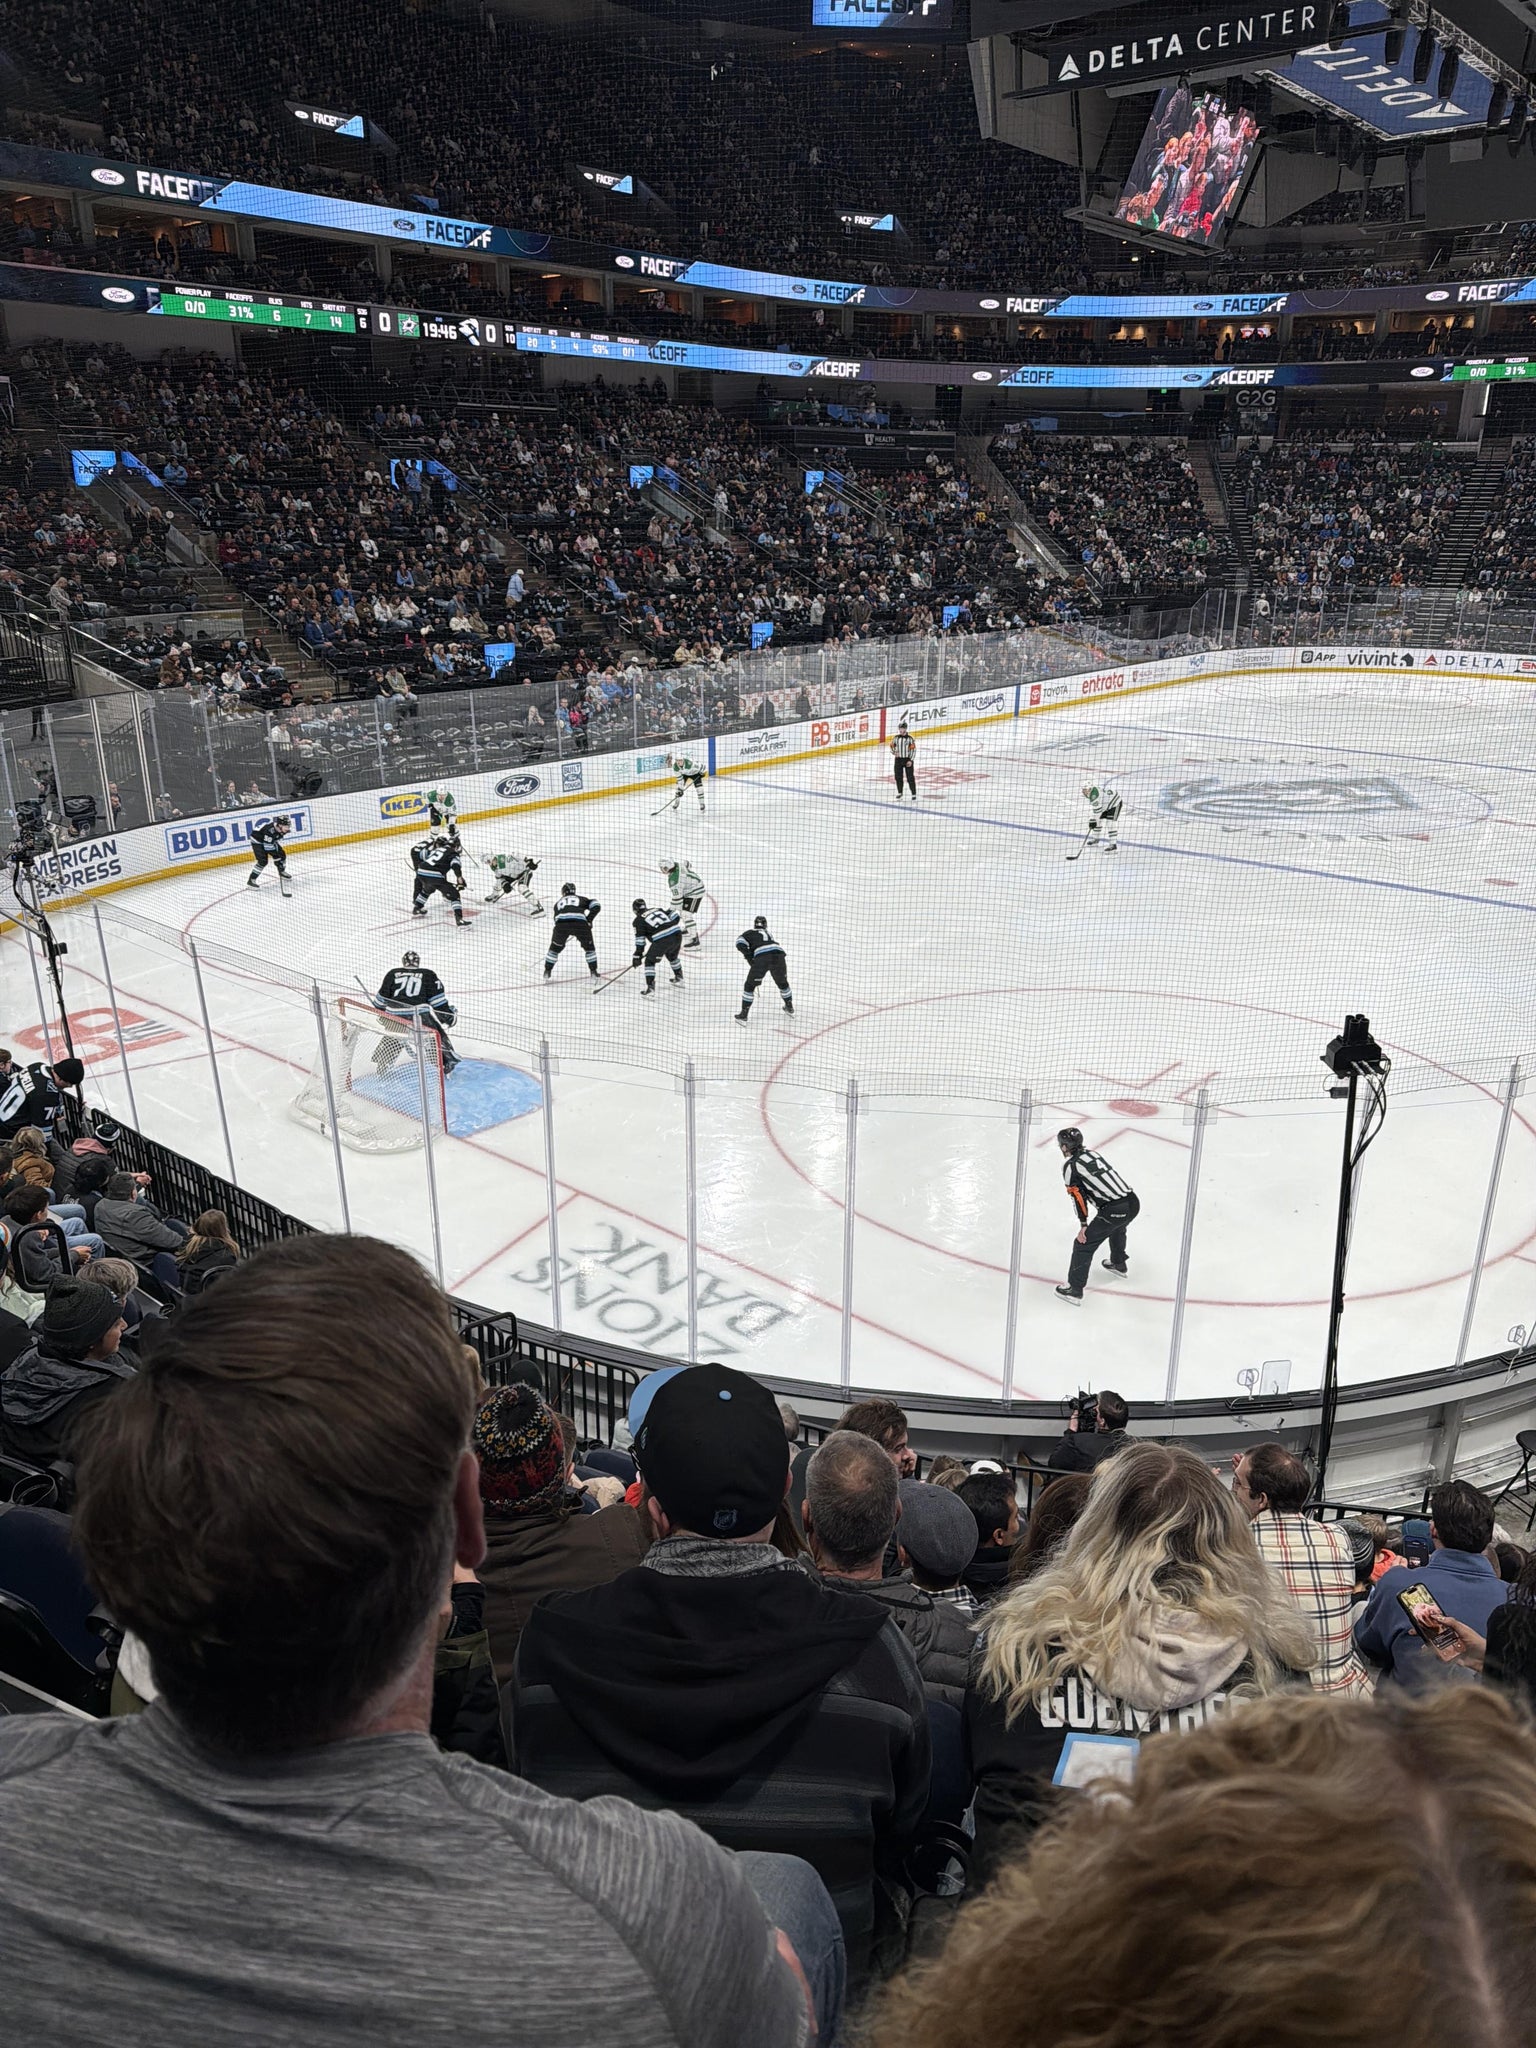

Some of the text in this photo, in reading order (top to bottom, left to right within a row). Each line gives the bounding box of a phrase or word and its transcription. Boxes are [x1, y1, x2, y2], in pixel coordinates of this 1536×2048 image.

[1088, 5, 1316, 73] DELTA CENTER
[425, 219, 492, 249] FACEOFF
[813, 283, 866, 303] FACEOFF
[184, 301, 206, 314] 0/0
[1222, 296, 1287, 312] FACEOFF
[229, 305, 254, 319] 31%
[273, 310, 281, 321] 6
[304, 313, 312, 324] 7
[330, 316, 342, 328] 14
[360, 317, 367, 329] 6
[379, 312, 391, 332] 0
[422, 322, 457, 340] 19:46
[485, 324, 496, 343] 0
[505, 333, 515, 344] 10
[527, 337, 538, 348] 20
[551, 340, 557, 349] 5
[573, 342, 579, 351] 4
[622, 347, 635, 357] 0/1
[1210, 369, 1275, 385] FACEOFF
[1470, 367, 1487, 377] 0/0
[1504, 366, 1526, 376] 31%
[1235, 389, 1277, 406] G2G
[1347, 649, 1398, 667] vivint
[1444, 655, 1504, 669] DELTA
[1081, 672, 1125, 695] entrata
[1043, 685, 1069, 698] TOYOTA
[908, 707, 947, 723] FILEVINE
[740, 744, 769, 756] AMERICA
[769, 740, 788, 751] FIRST
[385, 798, 423, 812] IKEA
[172, 812, 305, 853] BUD LIT
[34, 839, 118, 876] MERICAN
[394, 975, 422, 998] 70
